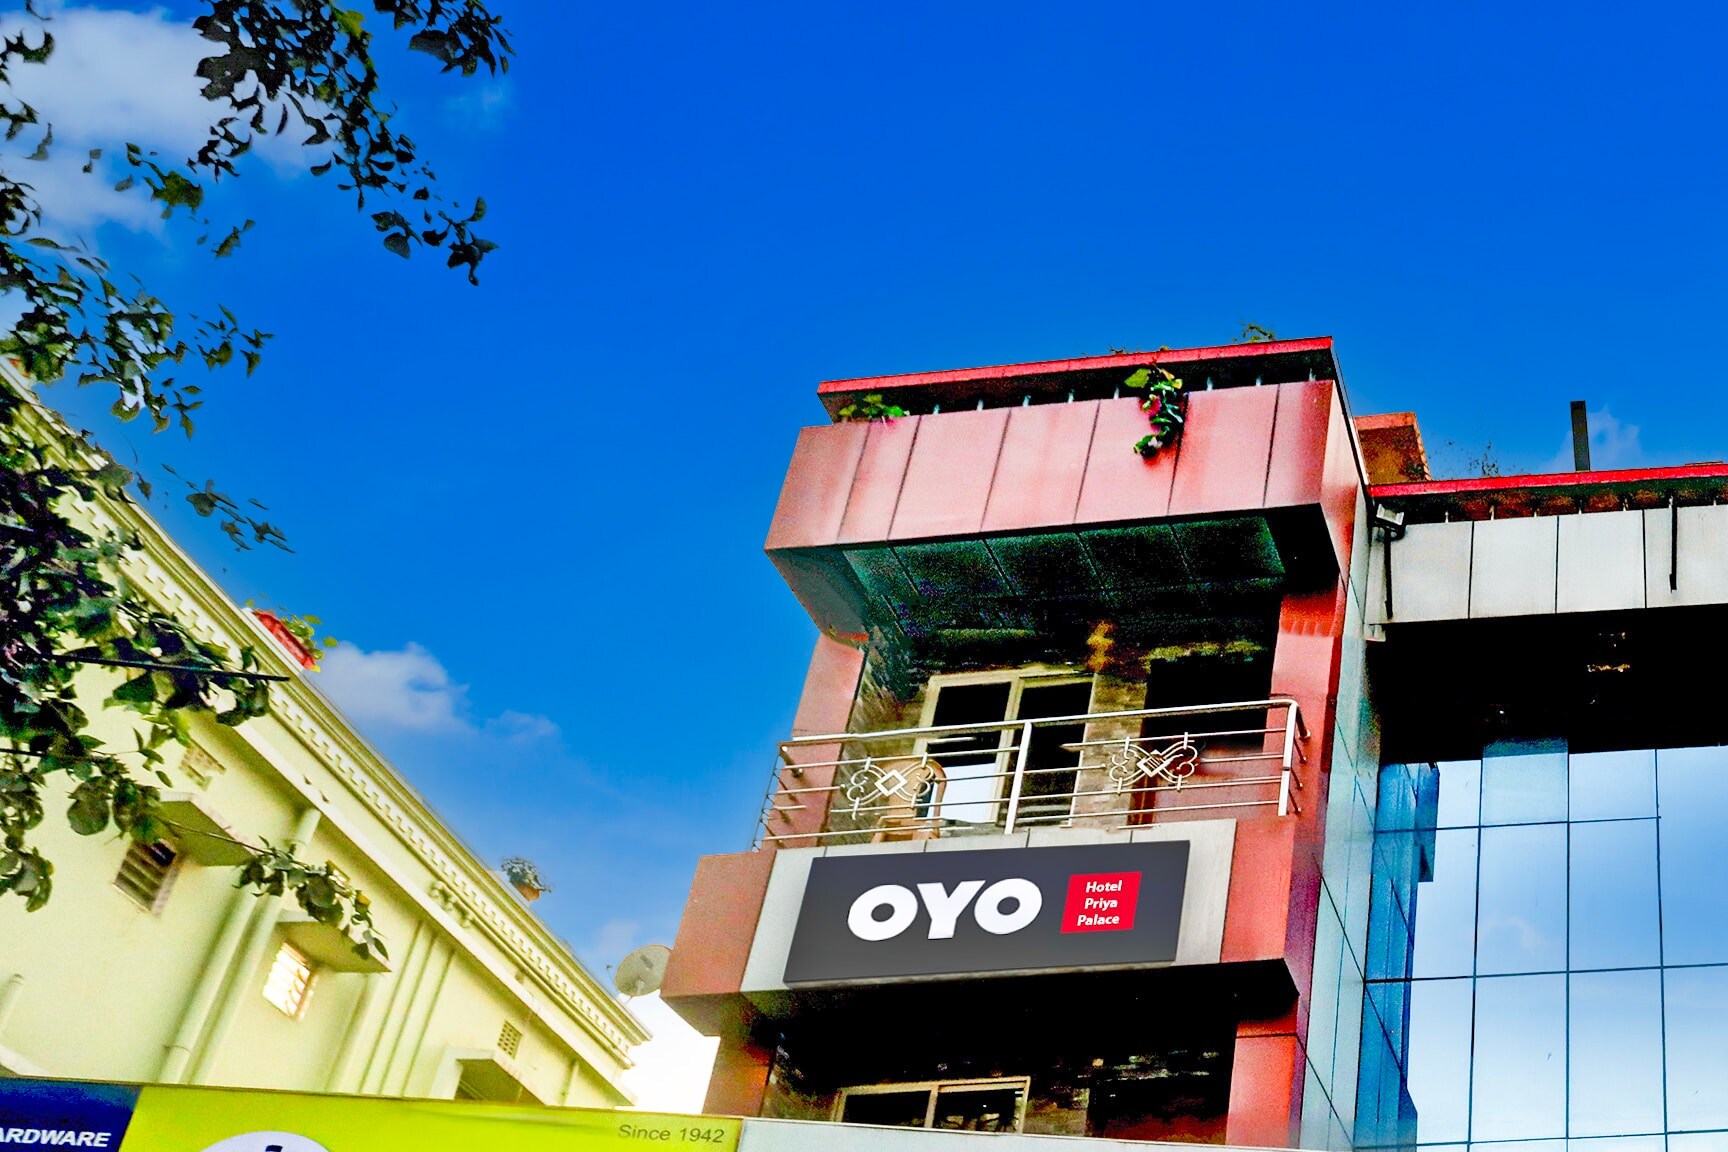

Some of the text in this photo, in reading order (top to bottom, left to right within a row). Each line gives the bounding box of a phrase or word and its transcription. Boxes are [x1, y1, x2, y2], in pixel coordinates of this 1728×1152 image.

[1086, 880, 1122, 894] Hotel
[847, 877, 1042, 941] OYO
[1084, 896, 1118, 912] Priya
[1077, 912, 1120, 926] Palace
[617, 1123, 725, 1144] Since 1942
